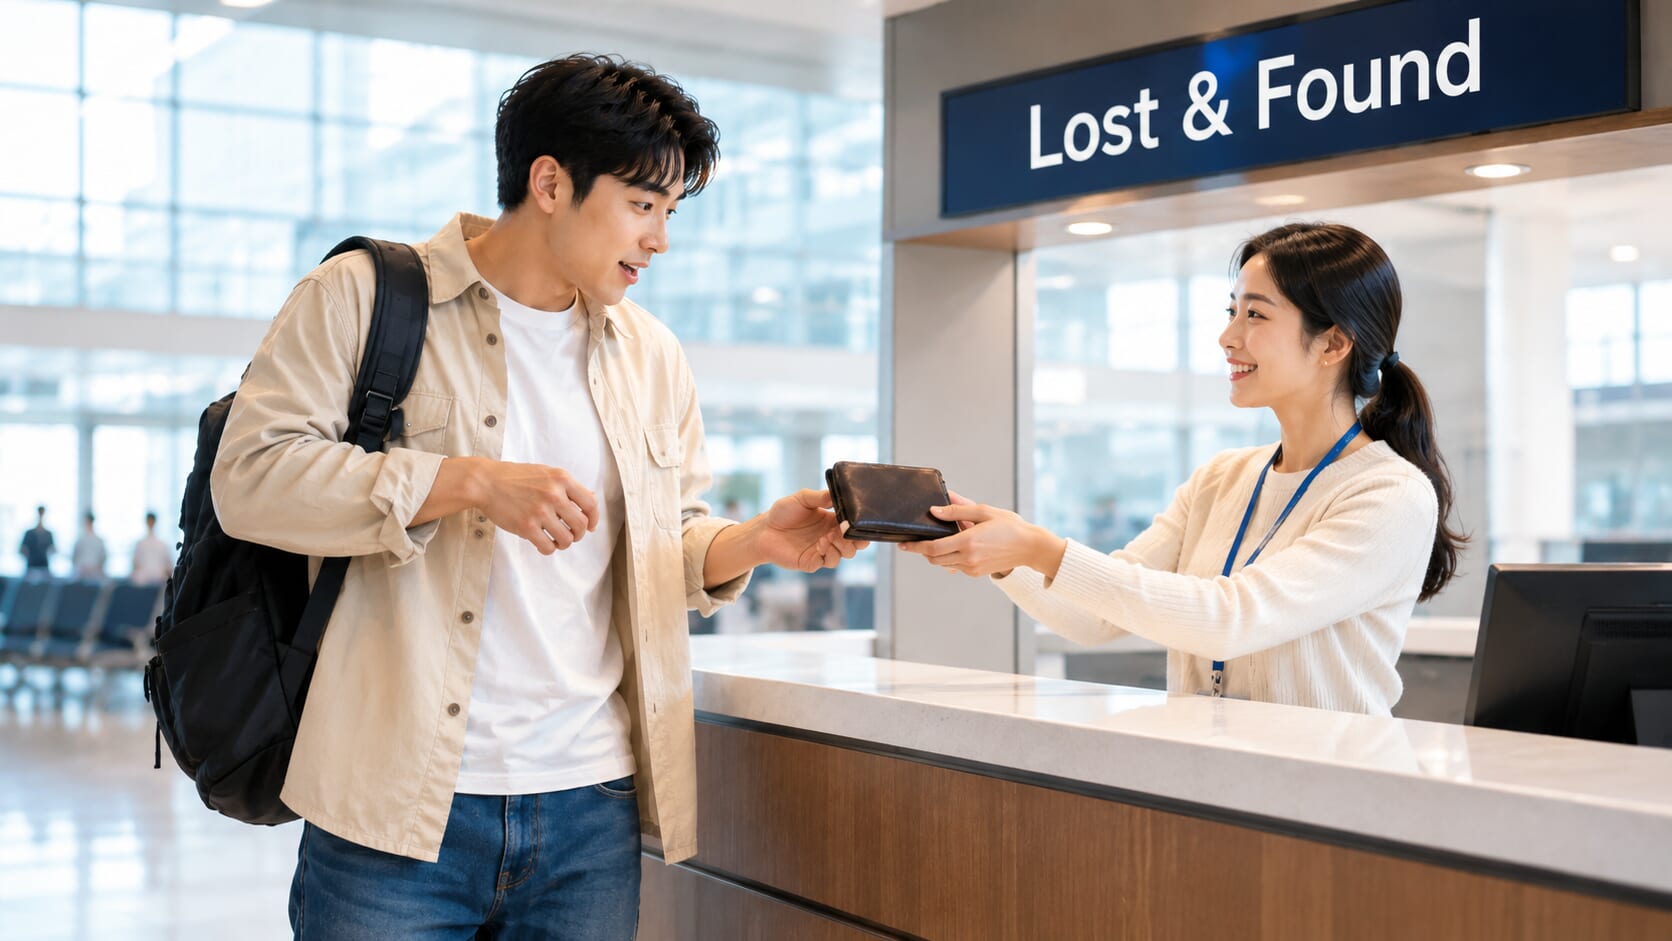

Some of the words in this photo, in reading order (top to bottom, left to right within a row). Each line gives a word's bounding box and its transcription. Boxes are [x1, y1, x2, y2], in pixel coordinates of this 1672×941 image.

[1030, 88, 1159, 170] Lost
[1182, 70, 1233, 141] &
[1258, 17, 1481, 130] Found
